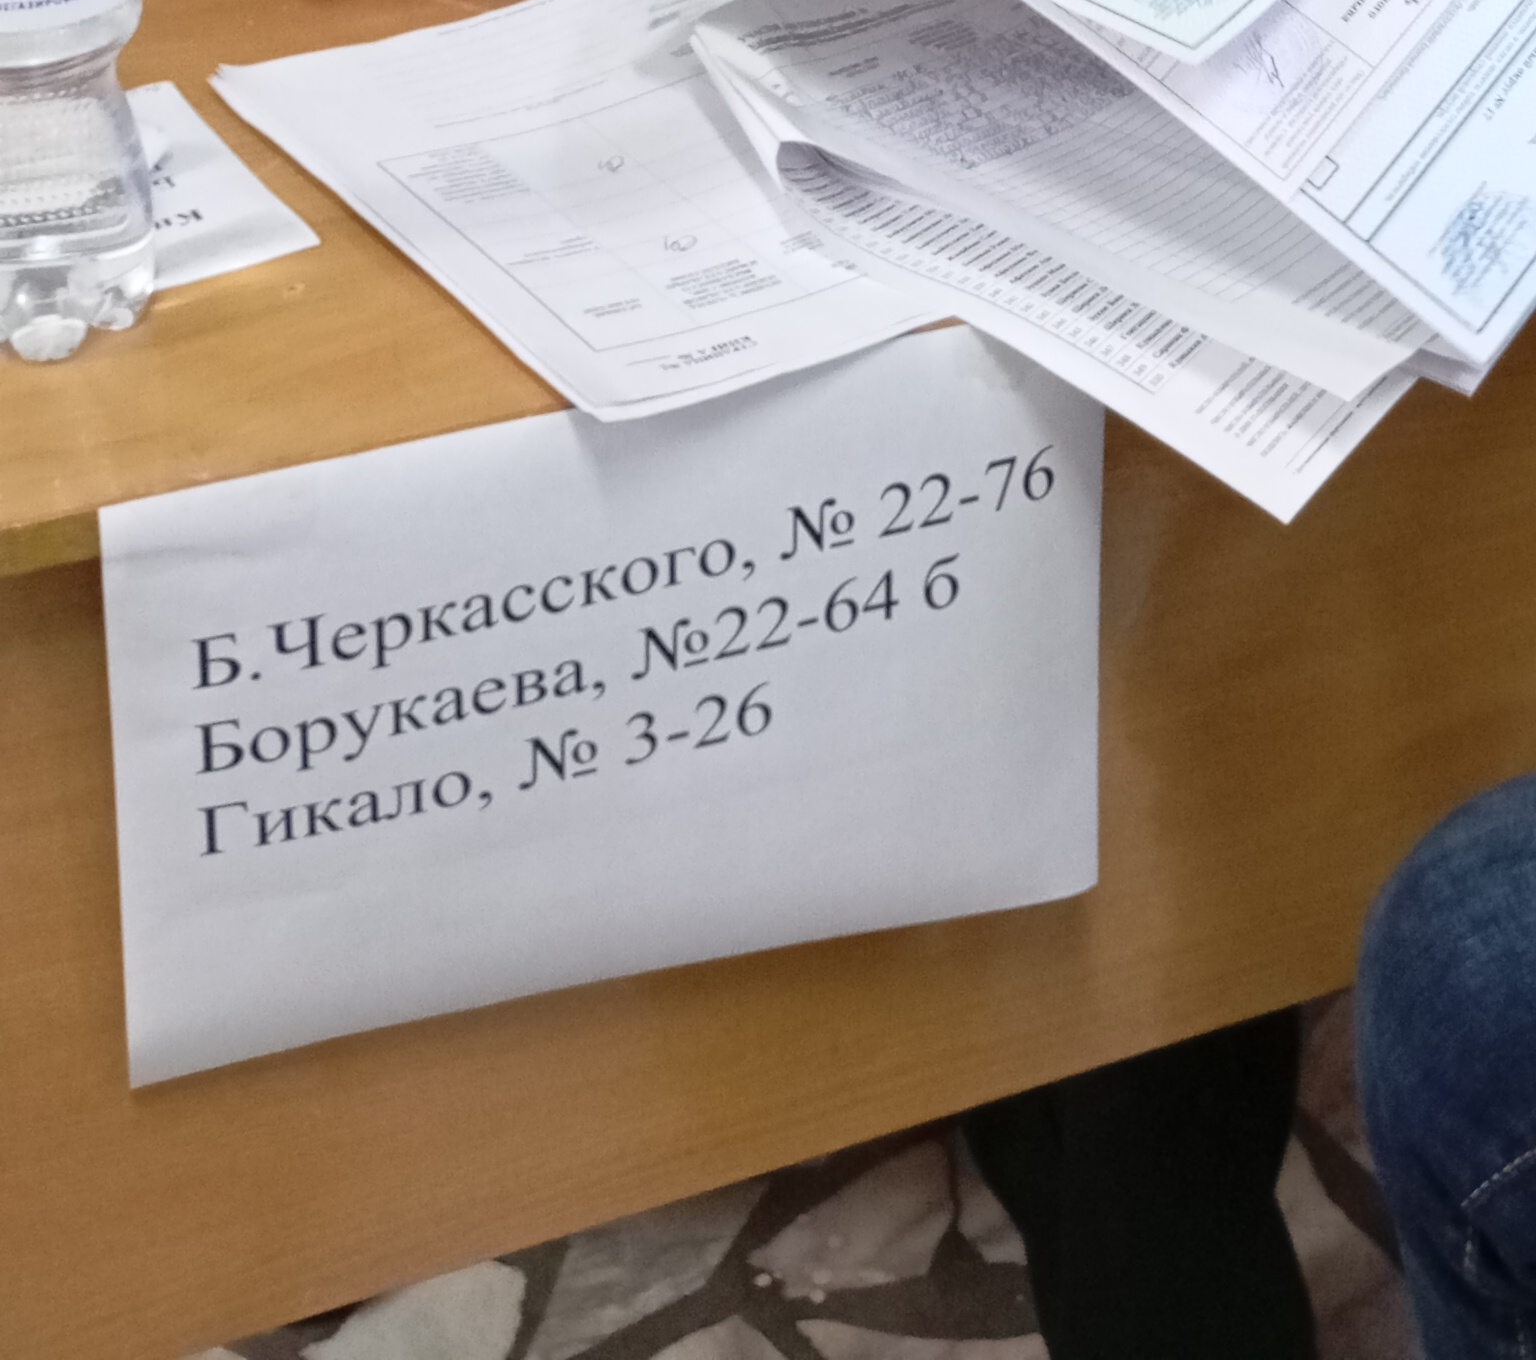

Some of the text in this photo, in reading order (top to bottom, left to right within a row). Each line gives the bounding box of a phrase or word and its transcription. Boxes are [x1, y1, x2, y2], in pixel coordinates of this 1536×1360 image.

[780, 498, 856, 561] №
[877, 443, 1057, 539] 22-76
[196, 553, 962, 776] Борукаева, №22-64 б
[199, 680, 774, 858] Гикало, № 3-26
